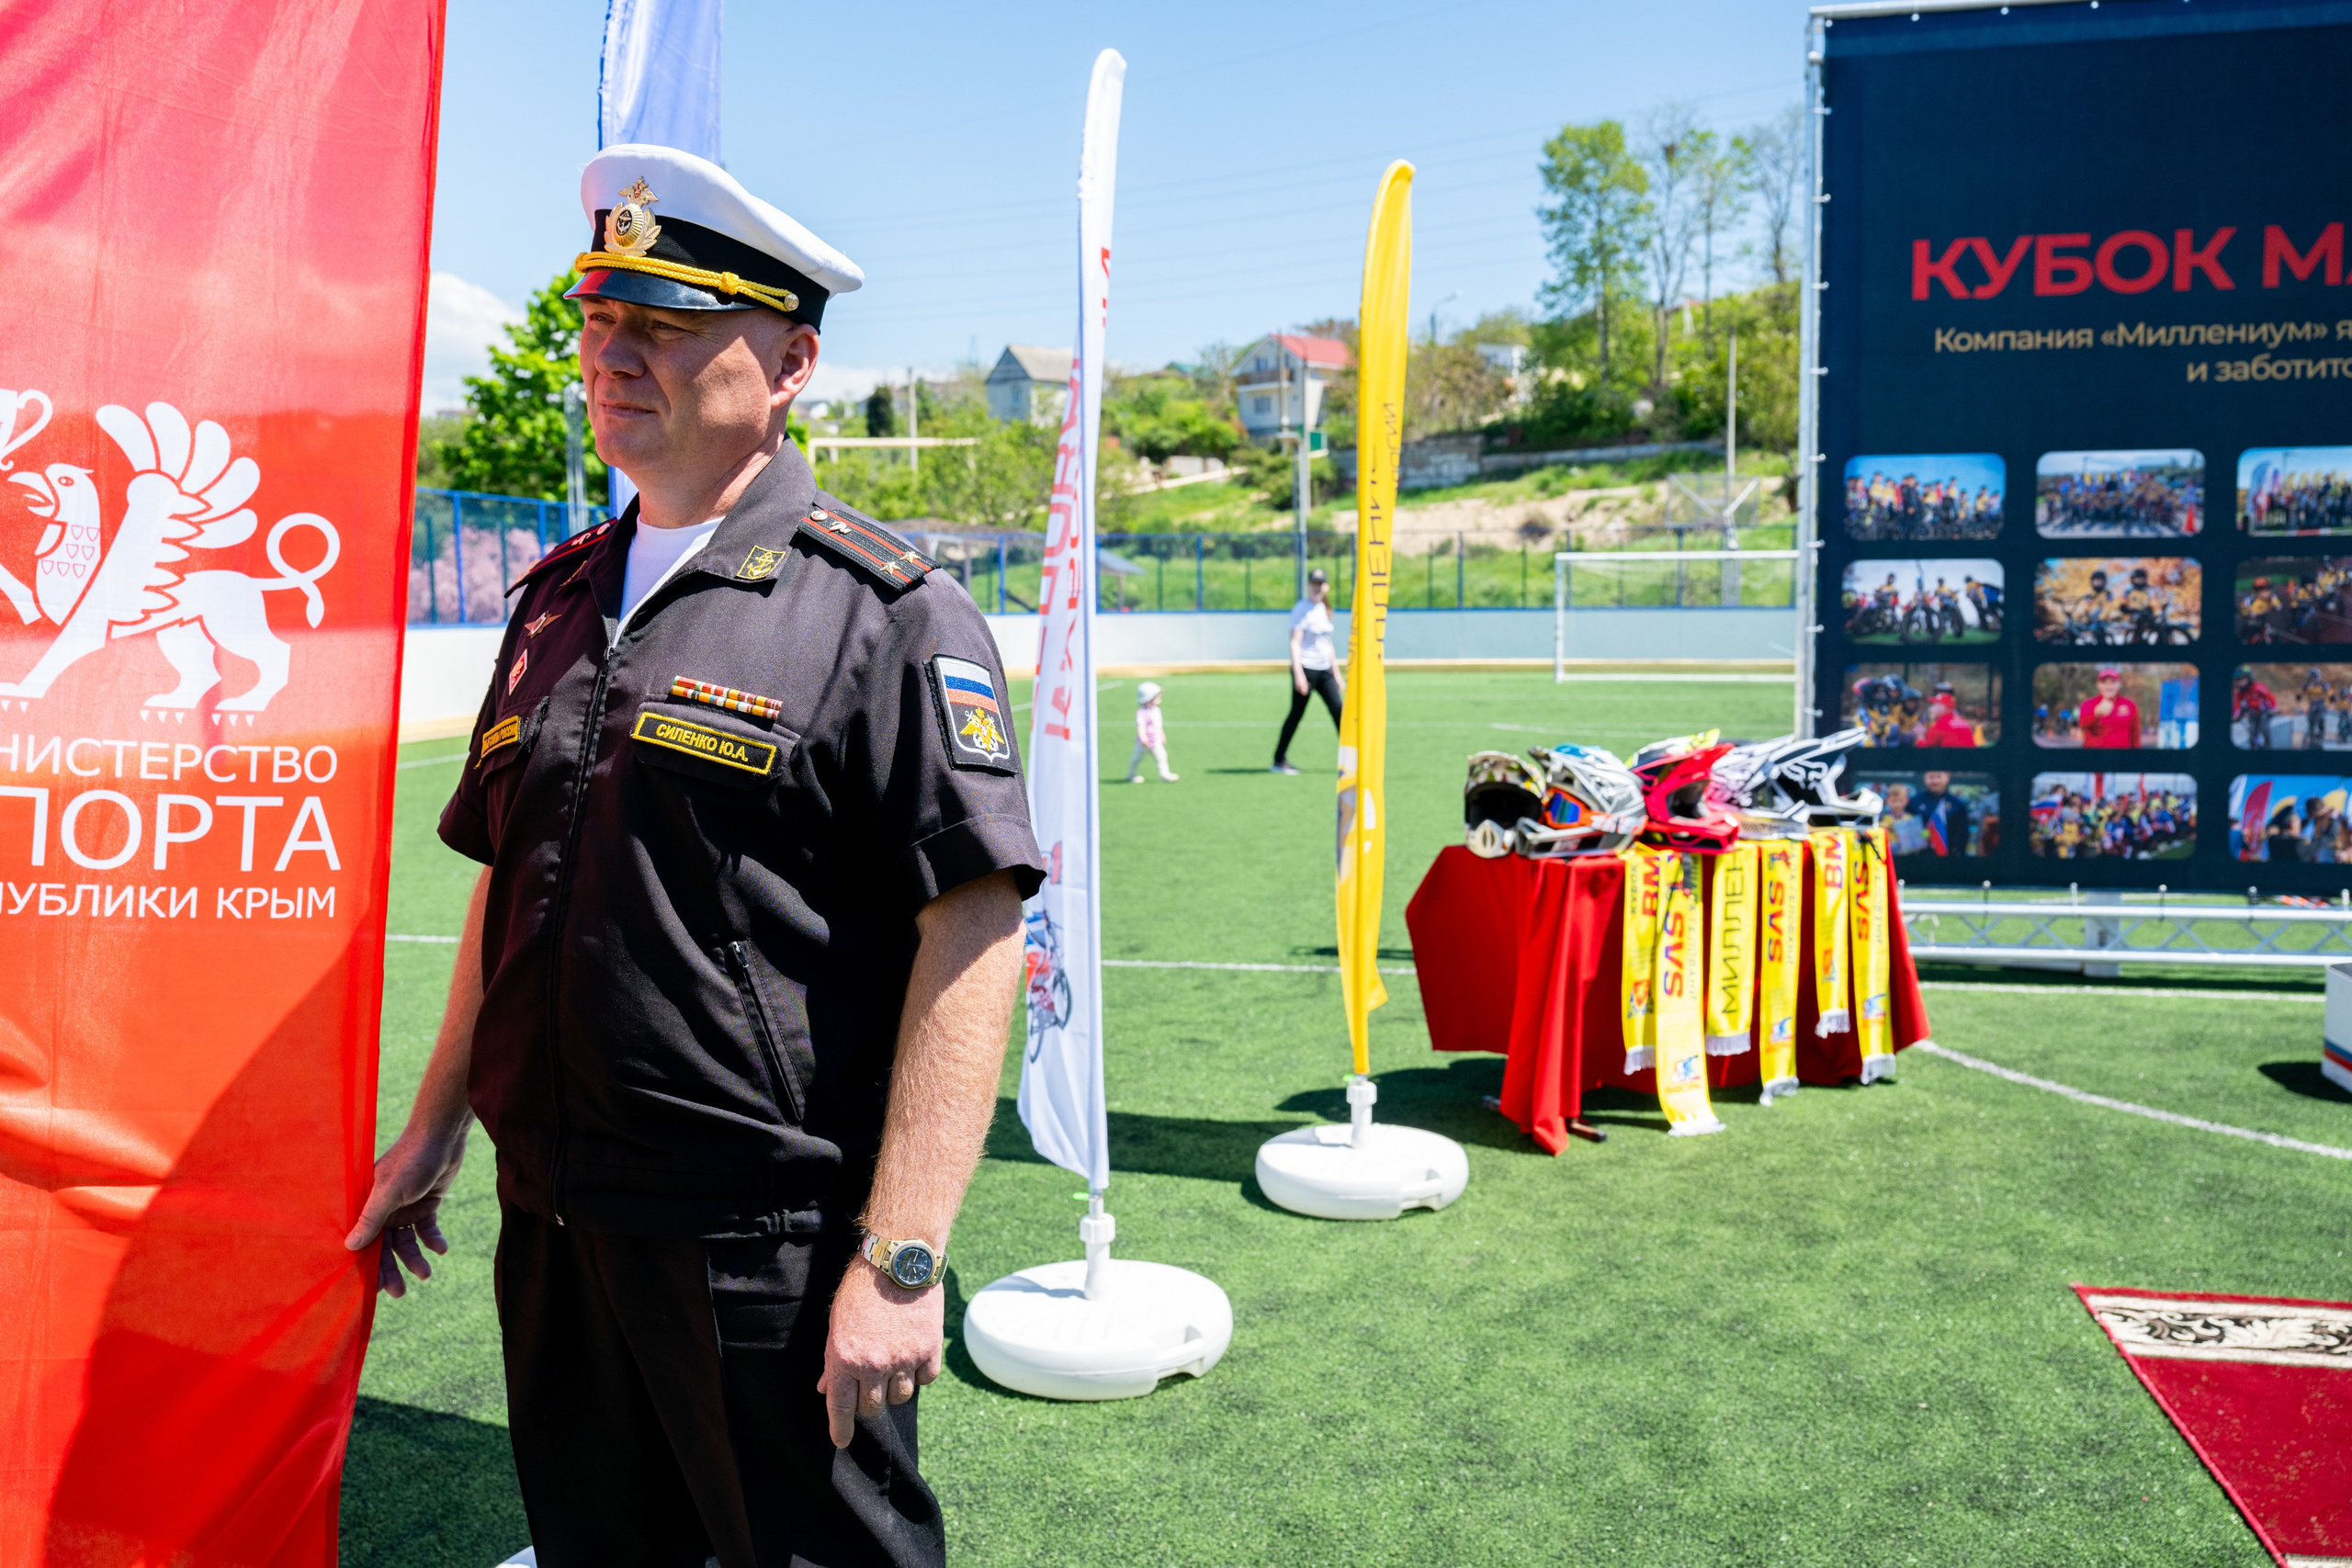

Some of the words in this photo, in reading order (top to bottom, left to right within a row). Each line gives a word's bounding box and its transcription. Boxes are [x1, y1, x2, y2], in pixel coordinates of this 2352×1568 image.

[1912, 226, 2238, 300] КУБОК
[2262, 221, 2352, 288] М
[1934, 326, 2094, 353] Компания
[2100, 321, 2328, 349] «Миллениум»
[2188, 362, 2208, 382] и
[656, 724, 718, 751] СИЛЕНКО
[718, 740, 749, 762] Ю.А.
[0, 880, 198, 918] УБЛИКИ
[217, 886, 335, 919] КРЫМ
[1768, 880, 1785, 964] SVS
[1854, 861, 1870, 942] SVS
[1664, 910, 1684, 998] SVS
